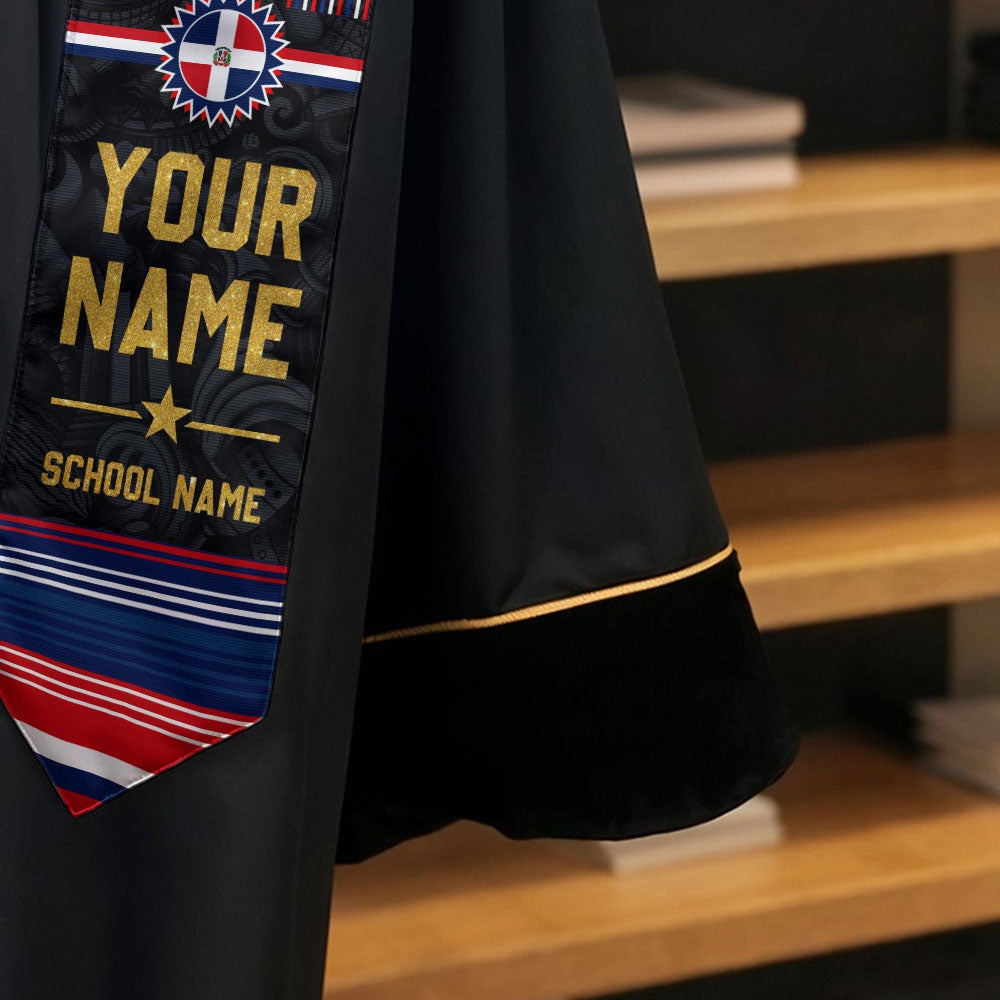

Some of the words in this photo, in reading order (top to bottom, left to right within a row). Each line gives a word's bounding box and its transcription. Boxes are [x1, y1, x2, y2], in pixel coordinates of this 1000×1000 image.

[97, 141, 318, 262] YOUR
[59, 256, 303, 380] NAME
[41, 451, 160, 506] SCHOOL
[172, 475, 266, 525] NAME
